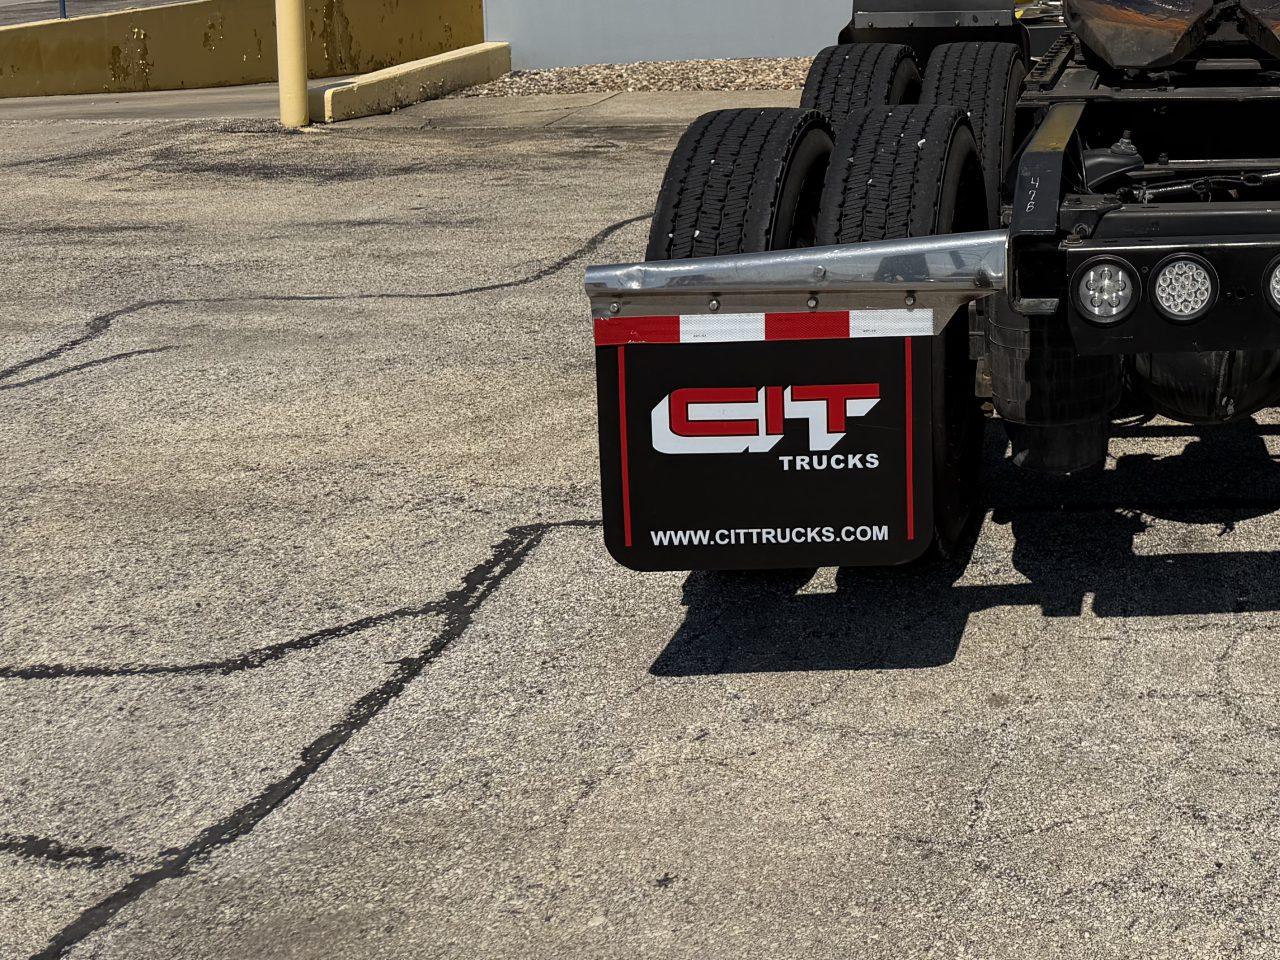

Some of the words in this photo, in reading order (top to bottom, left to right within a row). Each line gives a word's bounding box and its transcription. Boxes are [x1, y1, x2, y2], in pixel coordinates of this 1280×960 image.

[651, 383, 881, 454] CIT
[779, 453, 880, 471] TRUCKS
[651, 525, 889, 546] WWW.CITTRUCKS.COM
